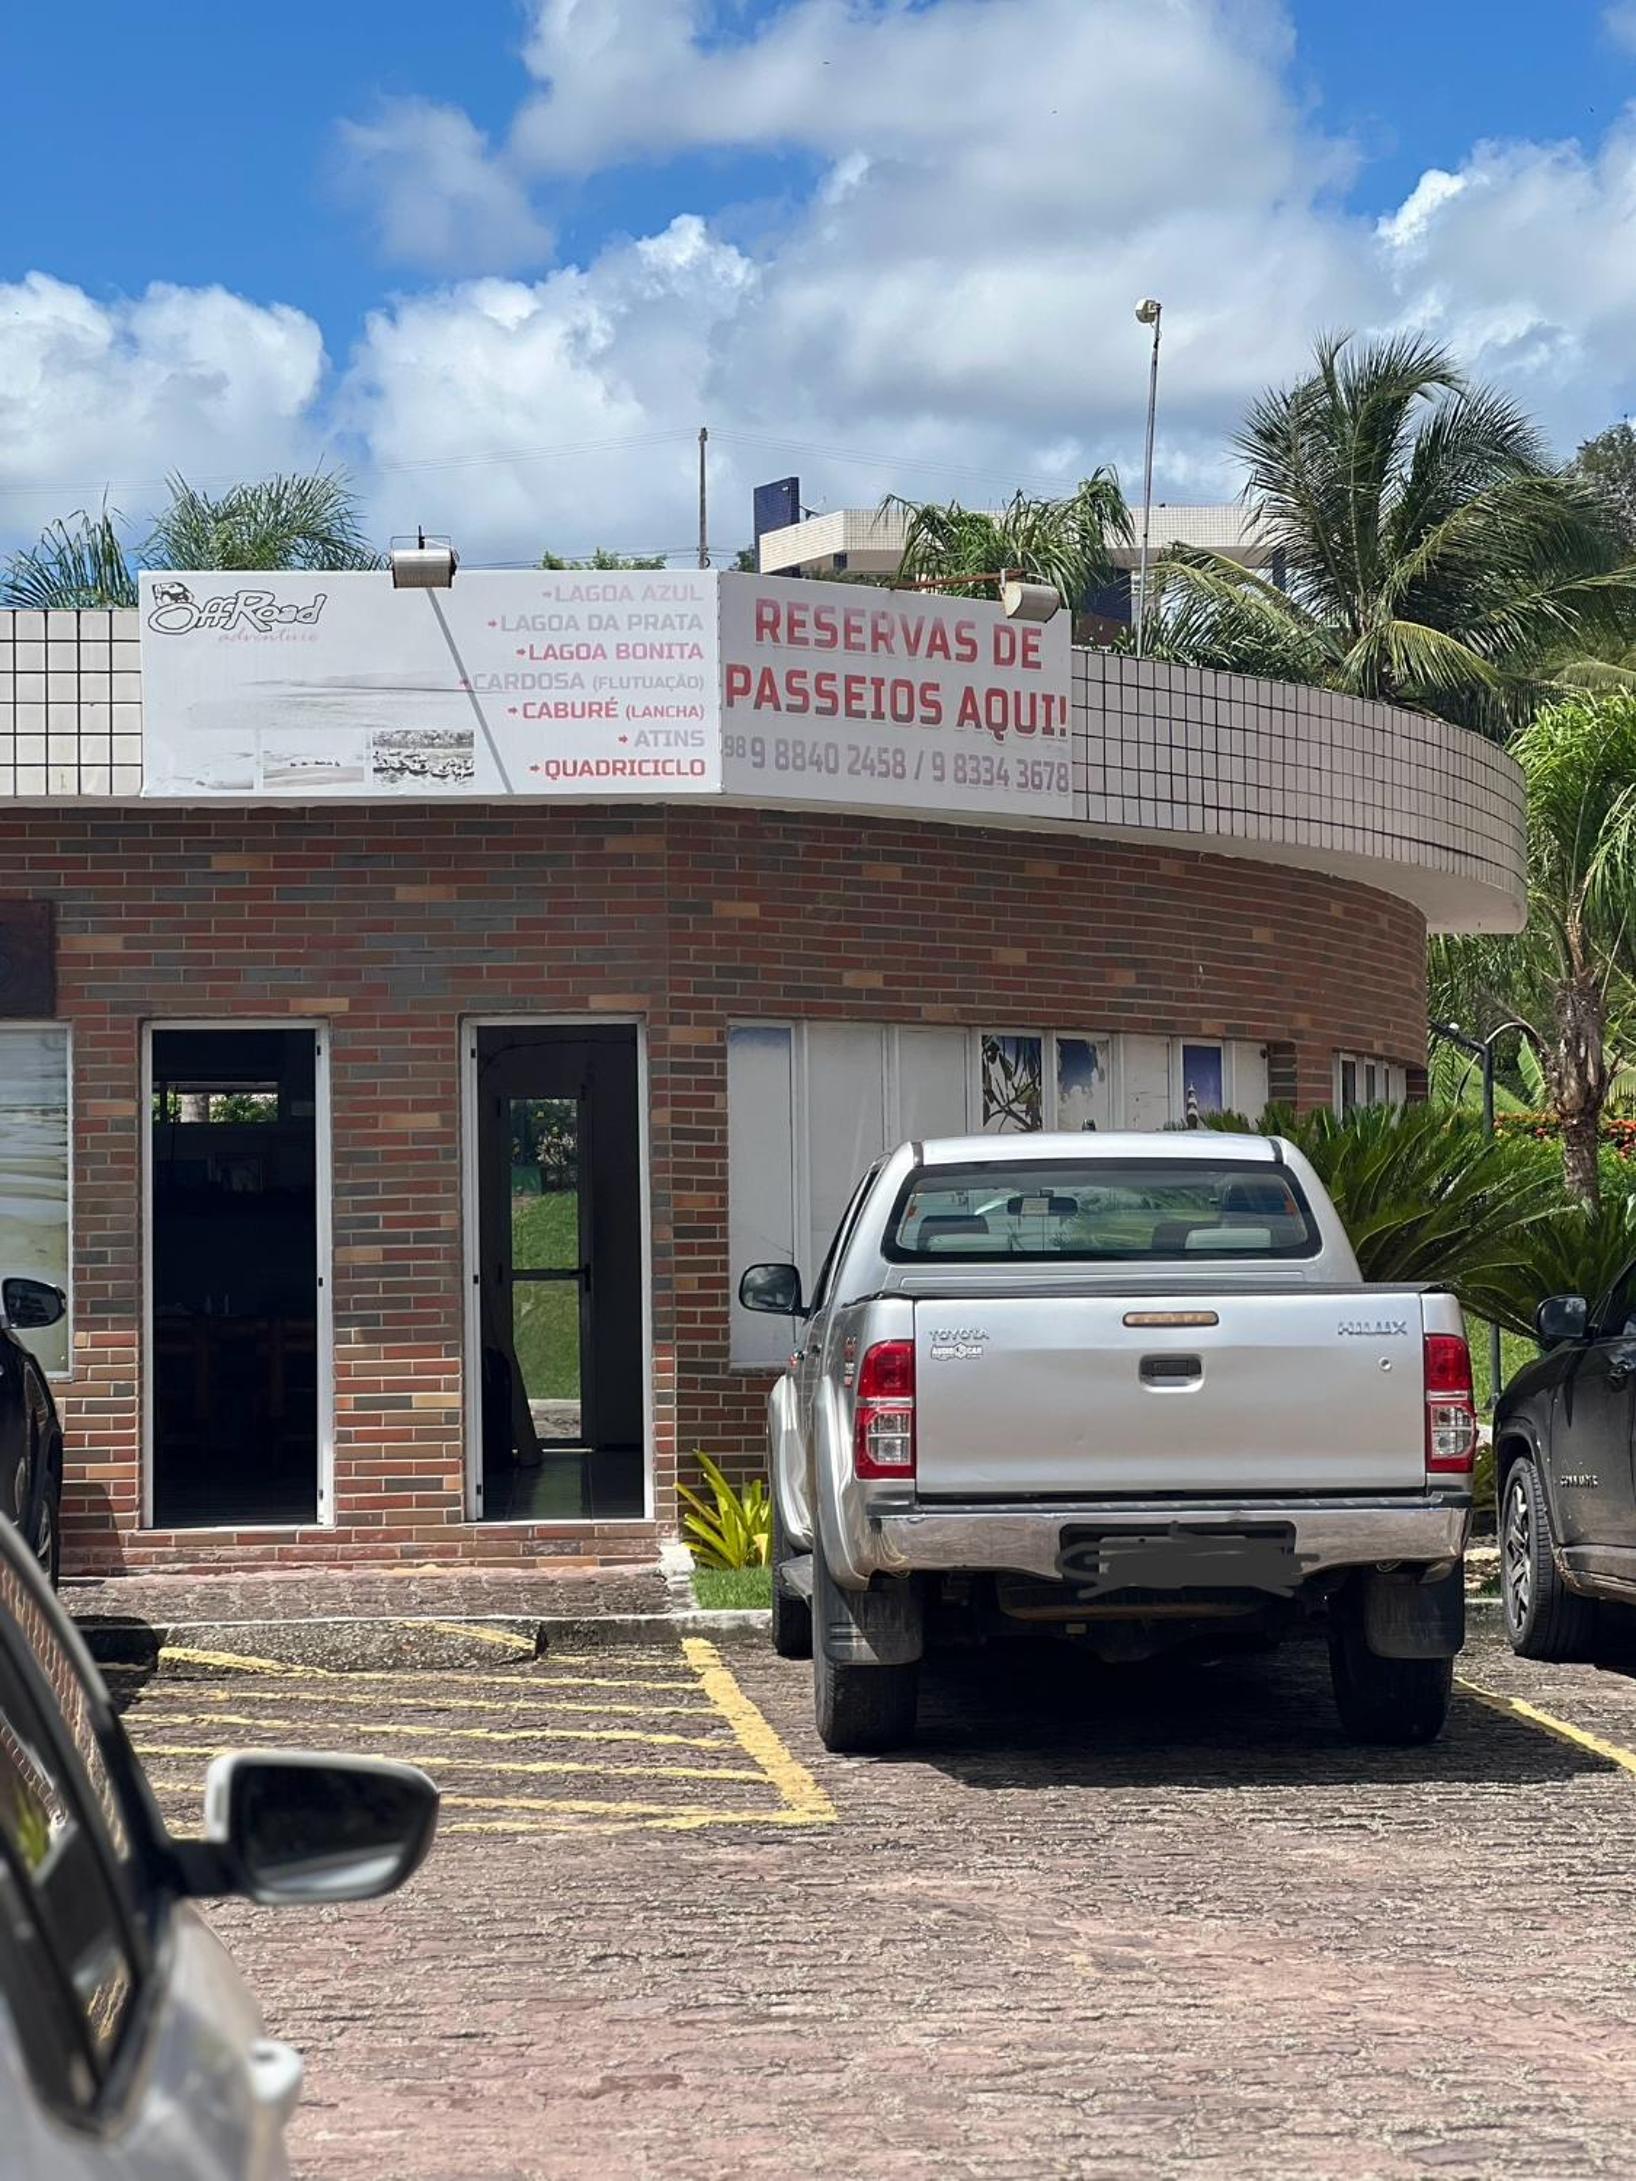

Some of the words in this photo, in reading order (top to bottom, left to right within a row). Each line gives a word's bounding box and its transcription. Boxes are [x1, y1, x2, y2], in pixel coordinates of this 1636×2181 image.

[555, 584, 634, 602] LAGOA
[642, 583, 704, 601] AZUL
[501, 615, 580, 632] LAGOA
[587, 614, 620, 631] DA
[627, 614, 704, 631] PRATA
[755, 598, 978, 663] RESERVAS
[993, 623, 1042, 670] DE
[528, 643, 607, 661] LAGOA
[615, 642, 704, 660] BONITA
[473, 672, 585, 690] CARDOSA
[592, 674, 705, 692] (FLUTUAÇÃO)
[523, 697, 619, 719] CABURÉ
[625, 704, 705, 720] (LANCHA)
[725, 664, 943, 725] PASSEIOS
[956, 686, 1067, 741] AQUI!
[634, 730, 705, 748] ATINS
[545, 758, 706, 780] QUADRICICLO
[775, 738, 840, 775] 8840
[847, 744, 907, 780] 2458
[914, 751, 924, 780] /
[932, 751, 946, 782] 9
[953, 753, 1010, 786] 8334
[1016, 758, 1070, 793] 3678
[929, 1329, 990, 1341] TOYOTA
[1338, 1321, 1407, 1335] HILUX
